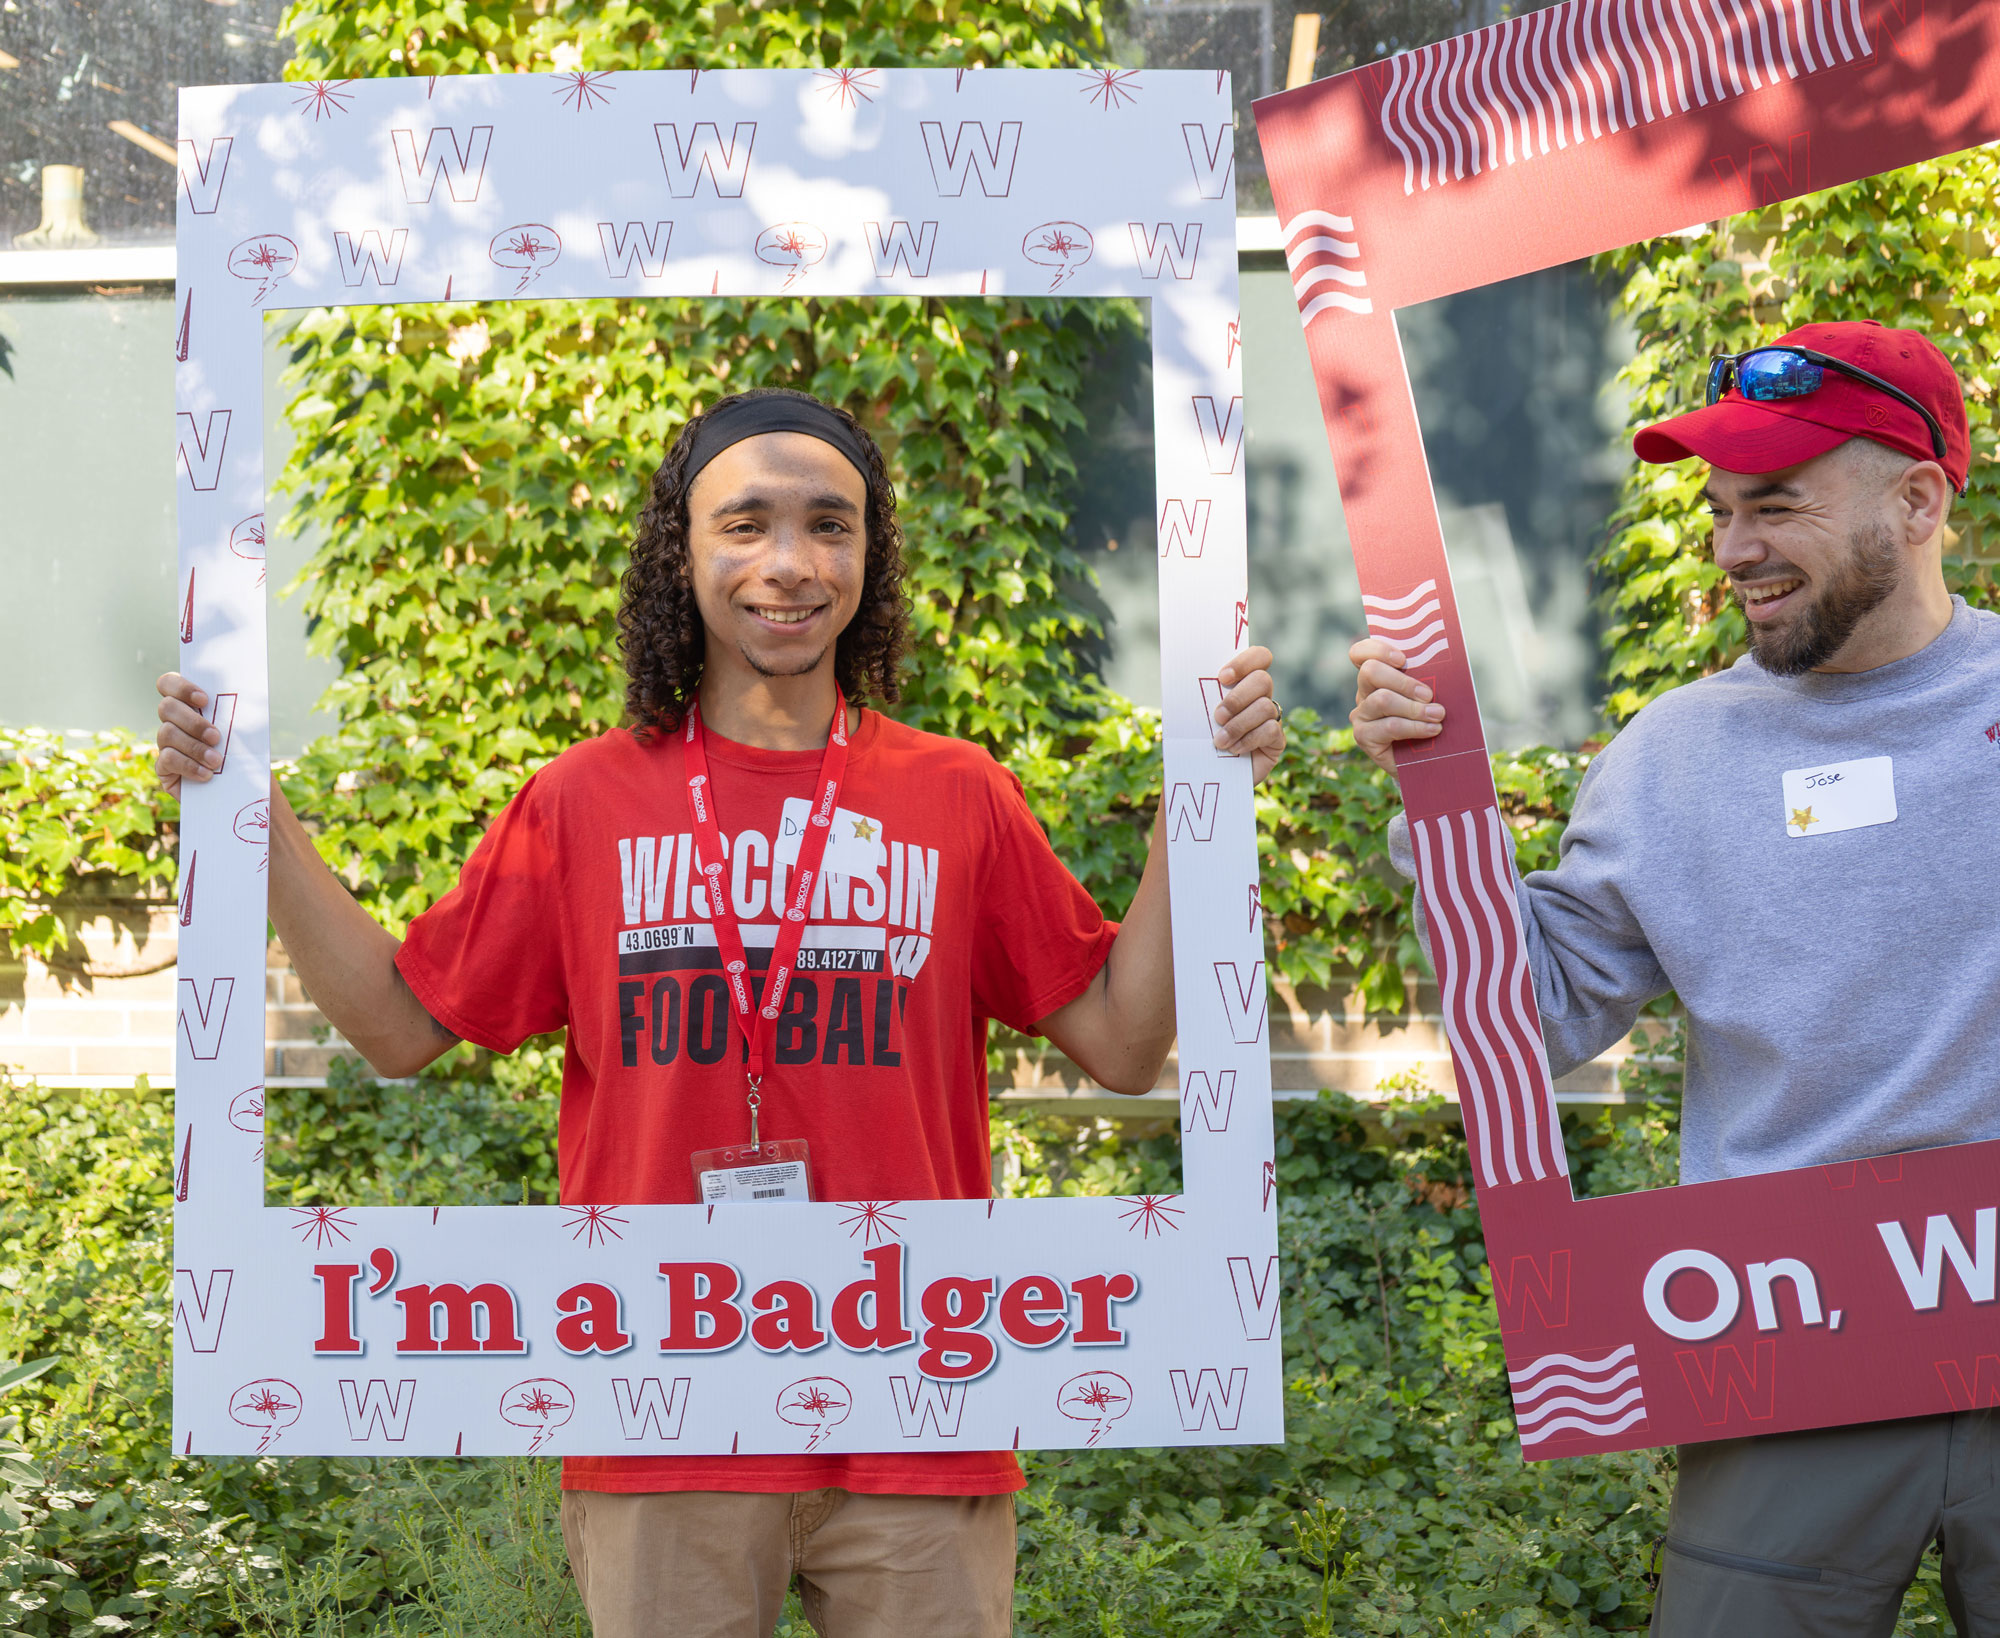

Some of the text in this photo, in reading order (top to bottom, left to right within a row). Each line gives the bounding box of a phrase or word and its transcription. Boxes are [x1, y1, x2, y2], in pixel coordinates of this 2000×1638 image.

[391, 125, 494, 204] W
[654, 121, 757, 199] W
[920, 121, 1023, 198] W
[334, 228, 409, 287] W
[597, 221, 674, 279] W
[863, 221, 939, 278] W
[1128, 223, 1203, 280] W
[820, 780, 835, 816] WISCONSIN
[1805, 771, 1845, 789] Jose
[712, 874, 726, 915] WISCONSIN
[795, 870, 811, 909] WISCONSIN
[770, 966, 787, 1008] WISCONSIN
[889, 935, 931, 980] W
[734, 972, 749, 1014] WISCONSIN
[313, 1241, 1137, 1381] I'm a Badger
[1642, 1248, 1842, 1341] On,
[338, 1379, 417, 1442] W
[611, 1377, 691, 1440] W
[888, 1376, 968, 1438] W
[1169, 1367, 1248, 1432] W
[1674, 1339, 1776, 1426] W
